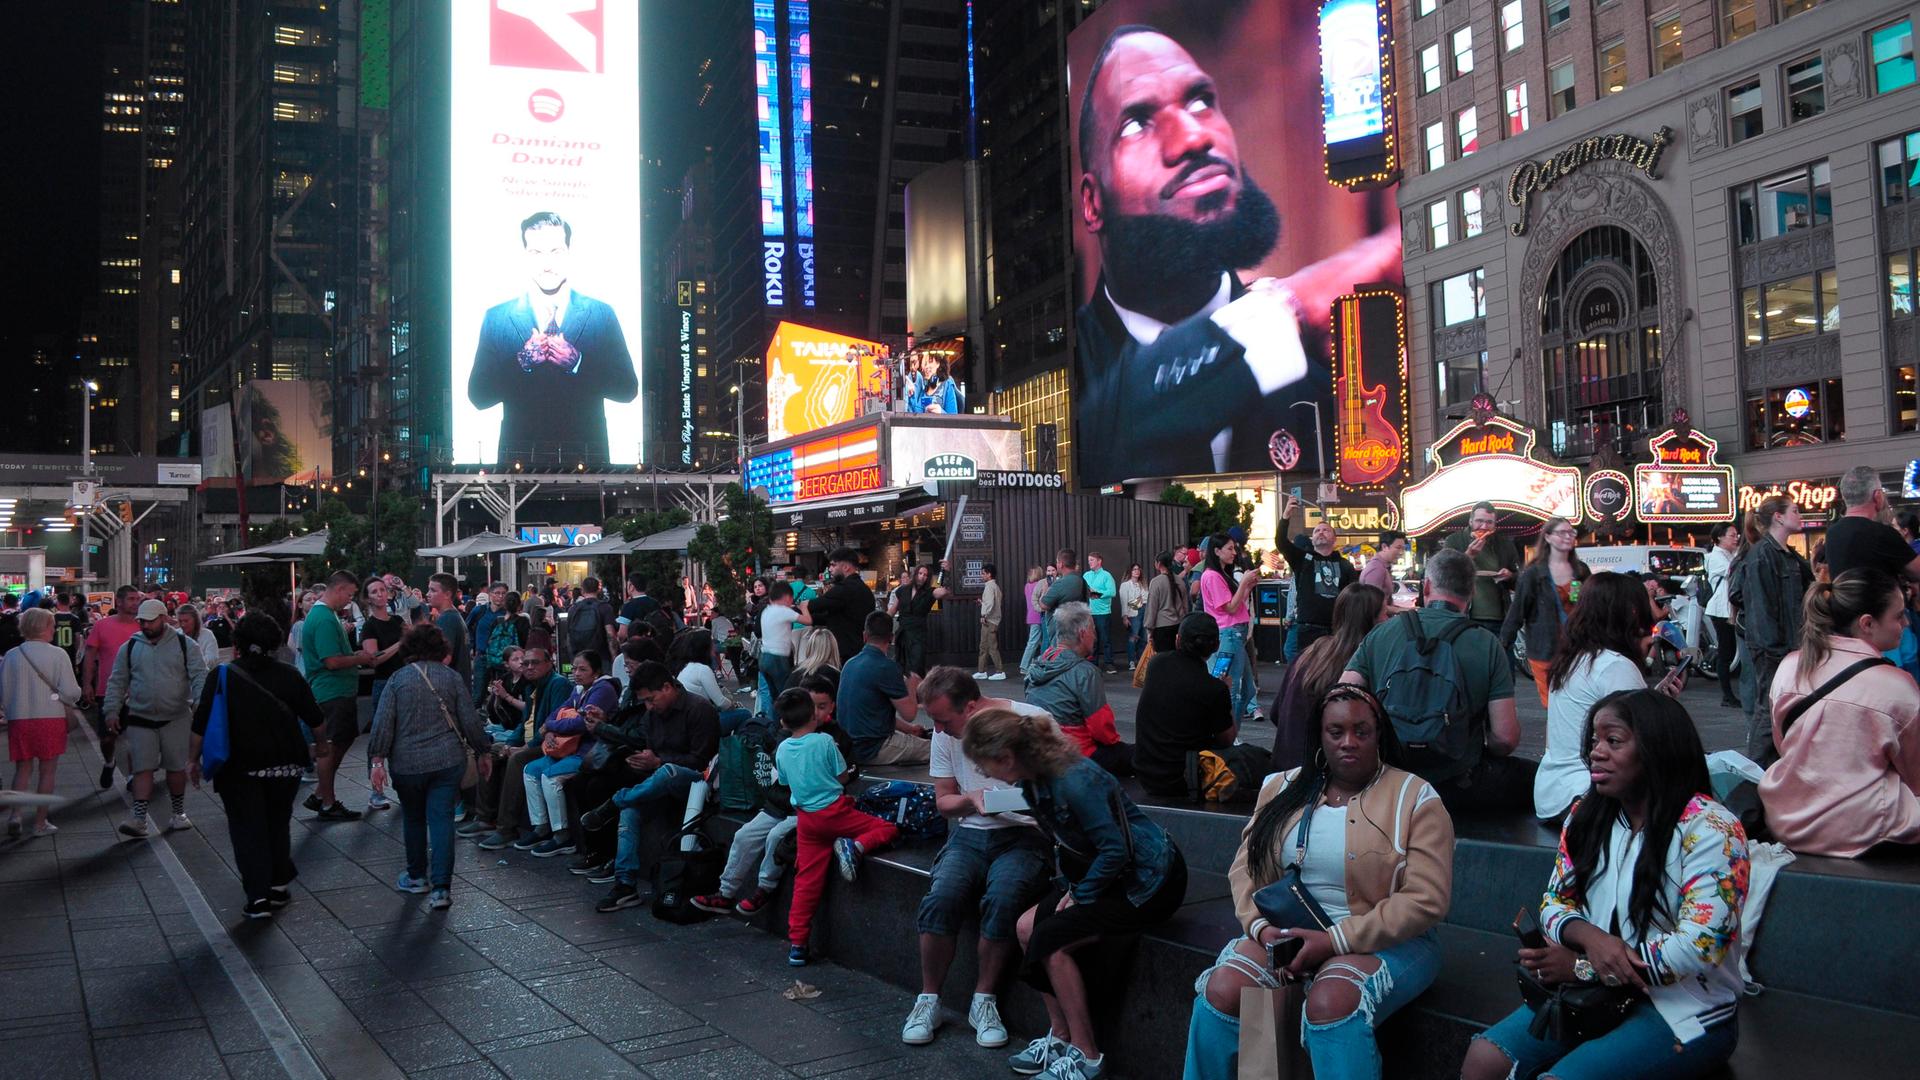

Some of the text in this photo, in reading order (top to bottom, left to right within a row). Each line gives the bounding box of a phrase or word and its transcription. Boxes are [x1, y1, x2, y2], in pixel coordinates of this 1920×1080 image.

[492, 132, 602, 150] Damiano
[511, 152, 584, 167] David
[1508, 125, 1676, 237] Paramount
[1590, 302, 1610, 316] 1501
[680, 311, 692, 341] Winery
[681, 342, 690, 351] &
[681, 353, 692, 392] Vineyard
[681, 393, 691, 419] Estate
[1461, 432, 1515, 455] Hard Rock
[1344, 445, 1397, 459] Hard Rock
[1680, 448, 1701, 463] Rock
[935, 455, 963, 466] BEER
[169, 471, 191, 479] Turner
[927, 467, 971, 477] GARDEN
[978, 472, 1062, 488] best HOTDOGS
[1607, 491, 1621, 500] Rock
[1788, 482, 1838, 510] Shop
[828, 505, 885, 518] HOTDOGS BEER WINE
[56, 626, 73, 647] 10
